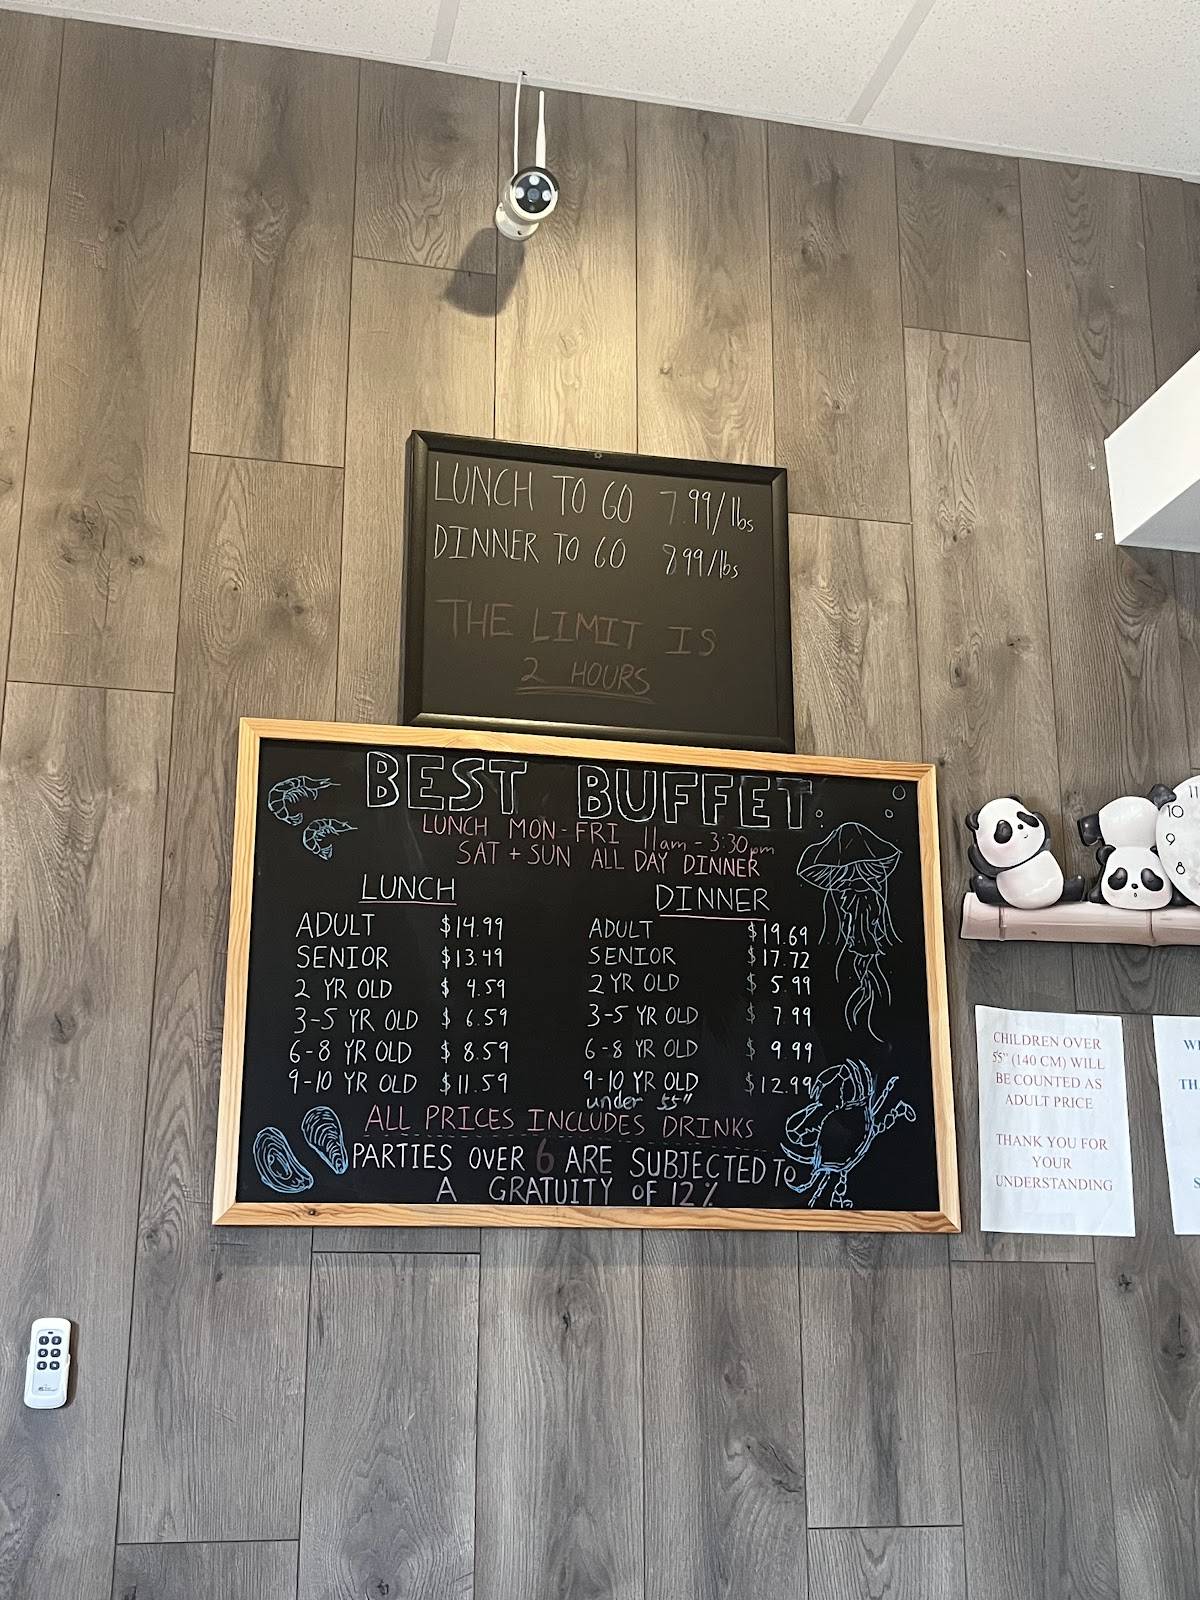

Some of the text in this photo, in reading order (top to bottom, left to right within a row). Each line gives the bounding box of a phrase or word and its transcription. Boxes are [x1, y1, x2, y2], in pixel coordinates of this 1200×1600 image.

[434, 460, 533, 511] LUNCH
[552, 475, 586, 516] TO
[602, 481, 633, 523] GO
[433, 524, 539, 564] DINNER
[553, 533, 580, 565] TO
[594, 537, 626, 569] GO
[435, 600, 717, 656] THE LIMIT IS
[521, 657, 651, 696] 2 HOURS
[366, 751, 813, 829] BEST BUFFET
[1167, 804, 1185, 818] 10
[423, 813, 488, 836] LUNCH
[1166, 833, 1176, 846] 9
[457, 841, 761, 877] SAT + SUN ALL DAY DINNER
[1176, 861, 1186, 875] 8
[361, 873, 456, 901] LUNCH
[655, 884, 770, 912] DINNER
[296, 911, 503, 940] ADULT $14.99
[588, 918, 808, 946] ADULT $19.69
[296, 945, 503, 970] SENIOR $13.49
[588, 945, 809, 969] SENIOR $17.72
[294, 979, 311, 999] 2
[325, 978, 348, 1000] YR
[357, 979, 393, 999] OLD
[587, 974, 605, 994] 2
[610, 973, 634, 993] YR
[644, 974, 680, 992] OLD
[294, 1007, 338, 1034] 3-5
[349, 1008, 375, 1033] YR
[385, 1010, 419, 1031] OLD
[587, 1003, 629, 1027] 3-5
[636, 1006, 657, 1026] YR
[665, 1006, 699, 1025] OLD
[289, 1039, 331, 1064] 6-8
[344, 1040, 367, 1065] YR
[375, 1040, 412, 1064] OLD
[584, 1038, 622, 1059] 6-8
[635, 1038, 656, 1059] YR
[663, 1039, 699, 1059] OLD
[993, 1031, 1102, 1050] CHILDREN OVER
[1011, 1054, 1037, 1068] (140
[1040, 1055, 1067, 1069] CM)
[1070, 1057, 1105, 1069] WILL
[288, 1068, 508, 1096] 9-10 YR OLD $11.59
[584, 1070, 812, 1096] 9-10 YR OLD $12.99
[996, 1072, 1102, 1089] BE COUNTED AS
[586, 1090, 643, 1111] under
[1005, 1094, 1094, 1109] ADULT PRICE
[364, 1105, 754, 1138] ALL PRICES INCLUDES DRINKS
[995, 1134, 1108, 1150] THANK YOU FOR
[353, 1143, 452, 1171] PARTIES
[469, 1146, 526, 1172] OVER
[536, 1138, 555, 1174] 6
[565, 1145, 612, 1174] ARE
[629, 1147, 766, 1185] SUBJECTED
[1032, 1156, 1072, 1169] YOUR
[436, 1176, 458, 1202] A
[488, 1176, 613, 1205] GRATUITY
[995, 1175, 1113, 1192] UNDERSTANDING
